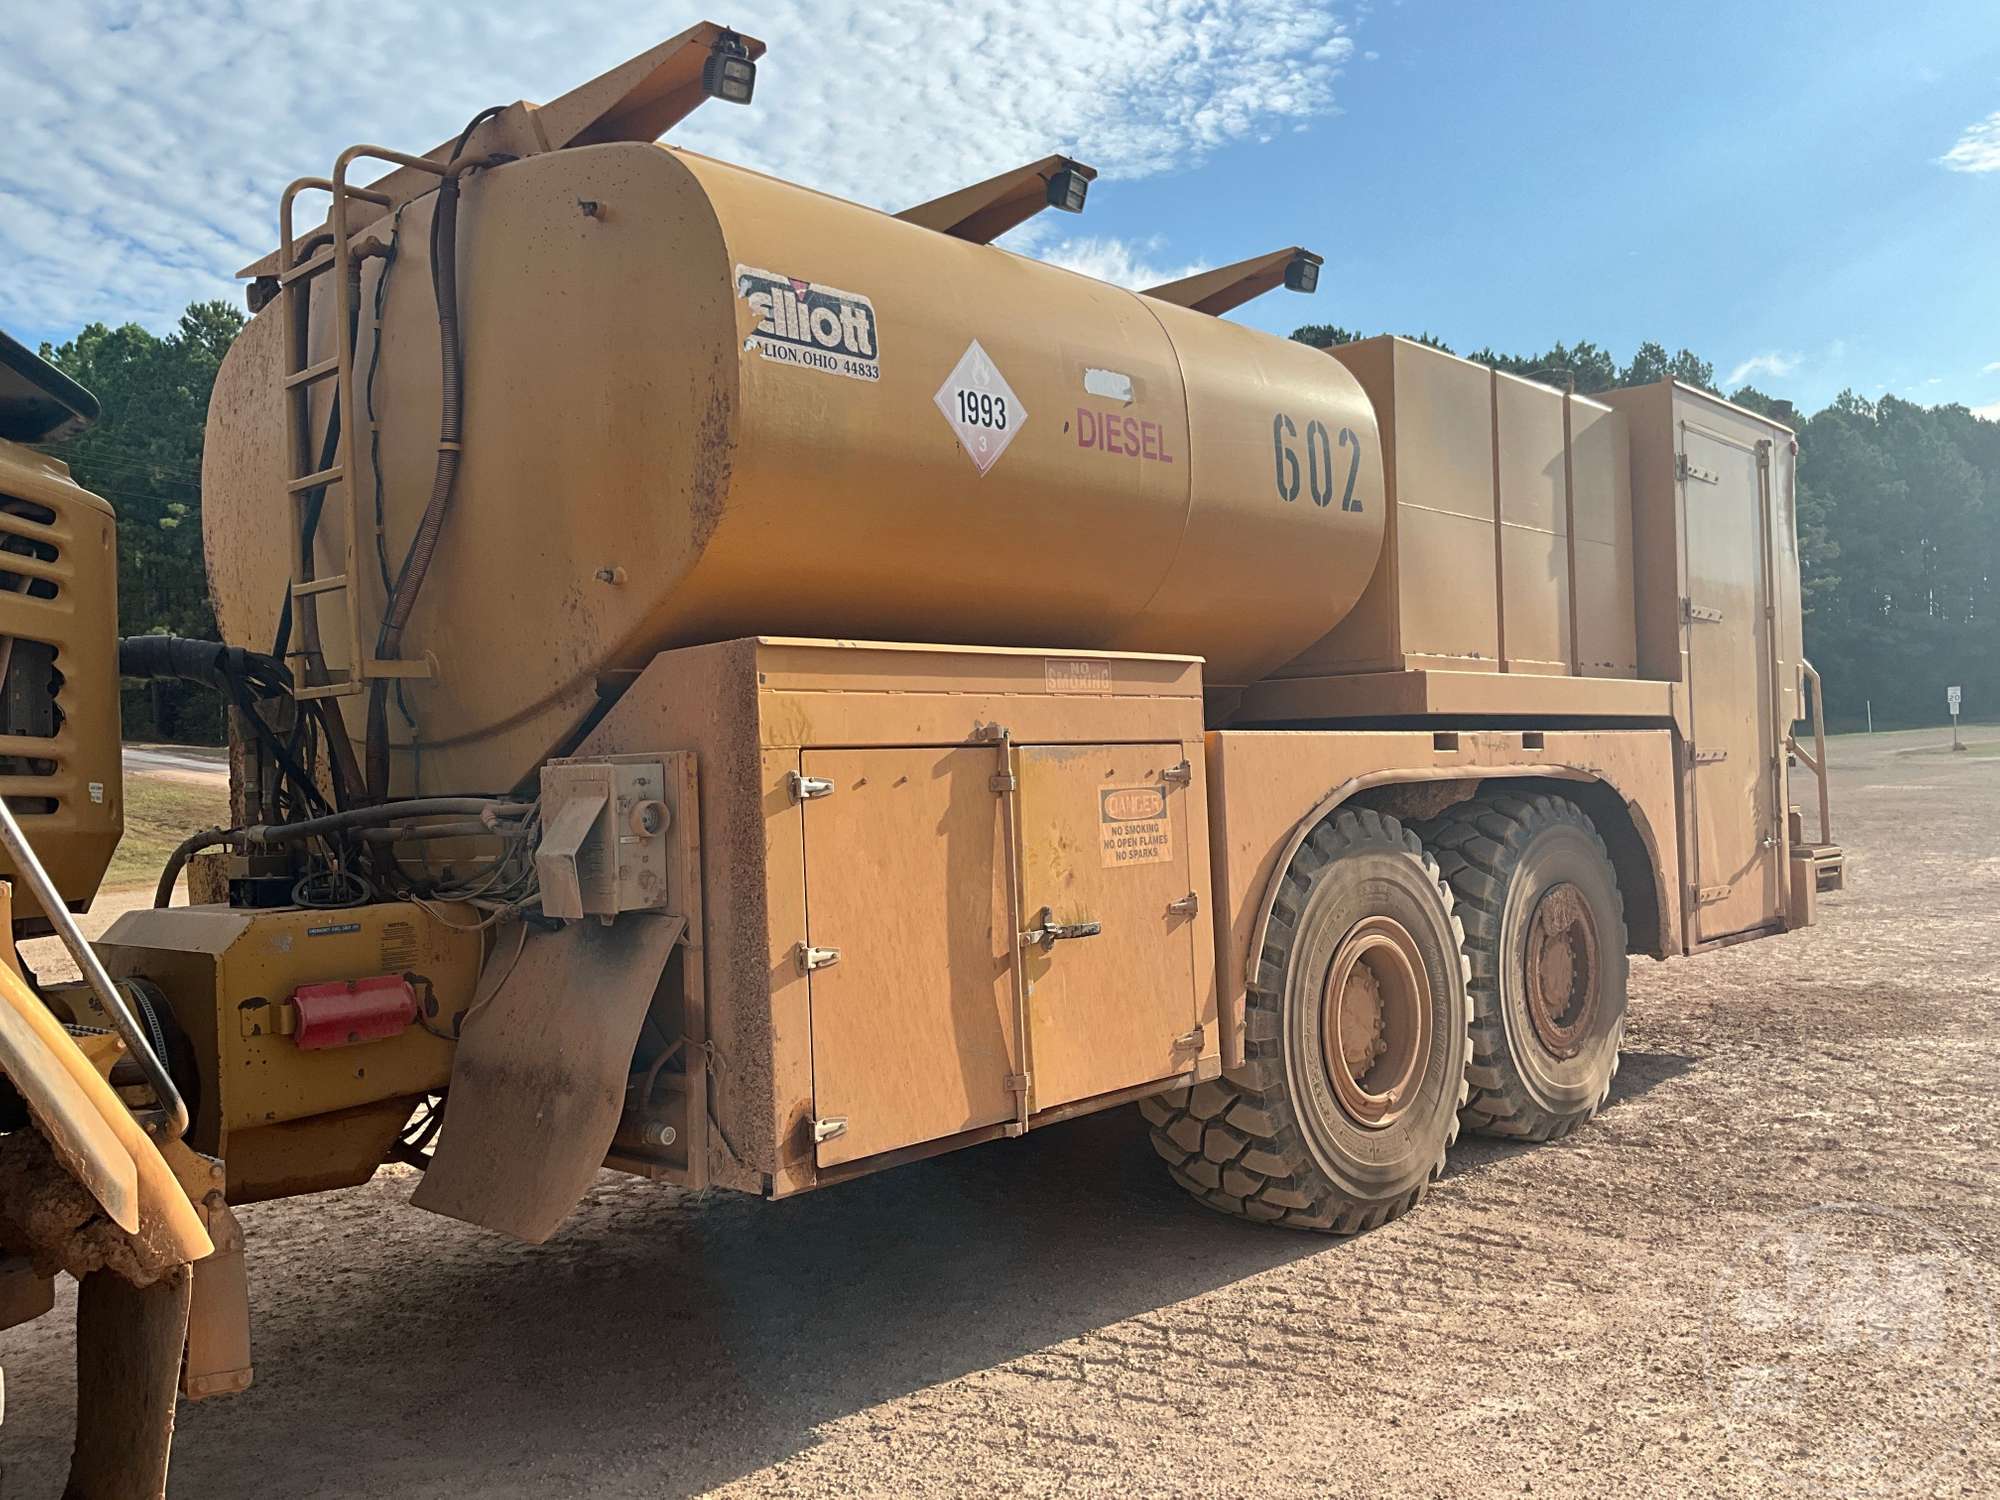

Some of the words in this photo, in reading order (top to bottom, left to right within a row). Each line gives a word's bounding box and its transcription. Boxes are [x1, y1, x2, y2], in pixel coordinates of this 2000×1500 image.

[755, 341, 801, 364] LION,
[802, 351, 838, 370] OHIO
[843, 360, 880, 379] 44833
[957, 389, 1008, 430] 1993
[978, 435, 988, 453] 3
[1076, 407, 1173, 464] DIESEL
[1273, 412, 1364, 513] 602
[1047, 668, 1109, 689] SMOKING
[1070, 662, 1089, 674] NO
[1108, 795, 1161, 816] DANGER
[1111, 826, 1123, 836] NO
[1125, 823, 1160, 836] SMOKING
[1103, 839, 1115, 849] NO
[1117, 837, 1137, 848] OPEN
[1139, 834, 1168, 846] FLAMES
[1115, 851, 1127, 861] NO
[1129, 847, 1158, 860] SPARKS
